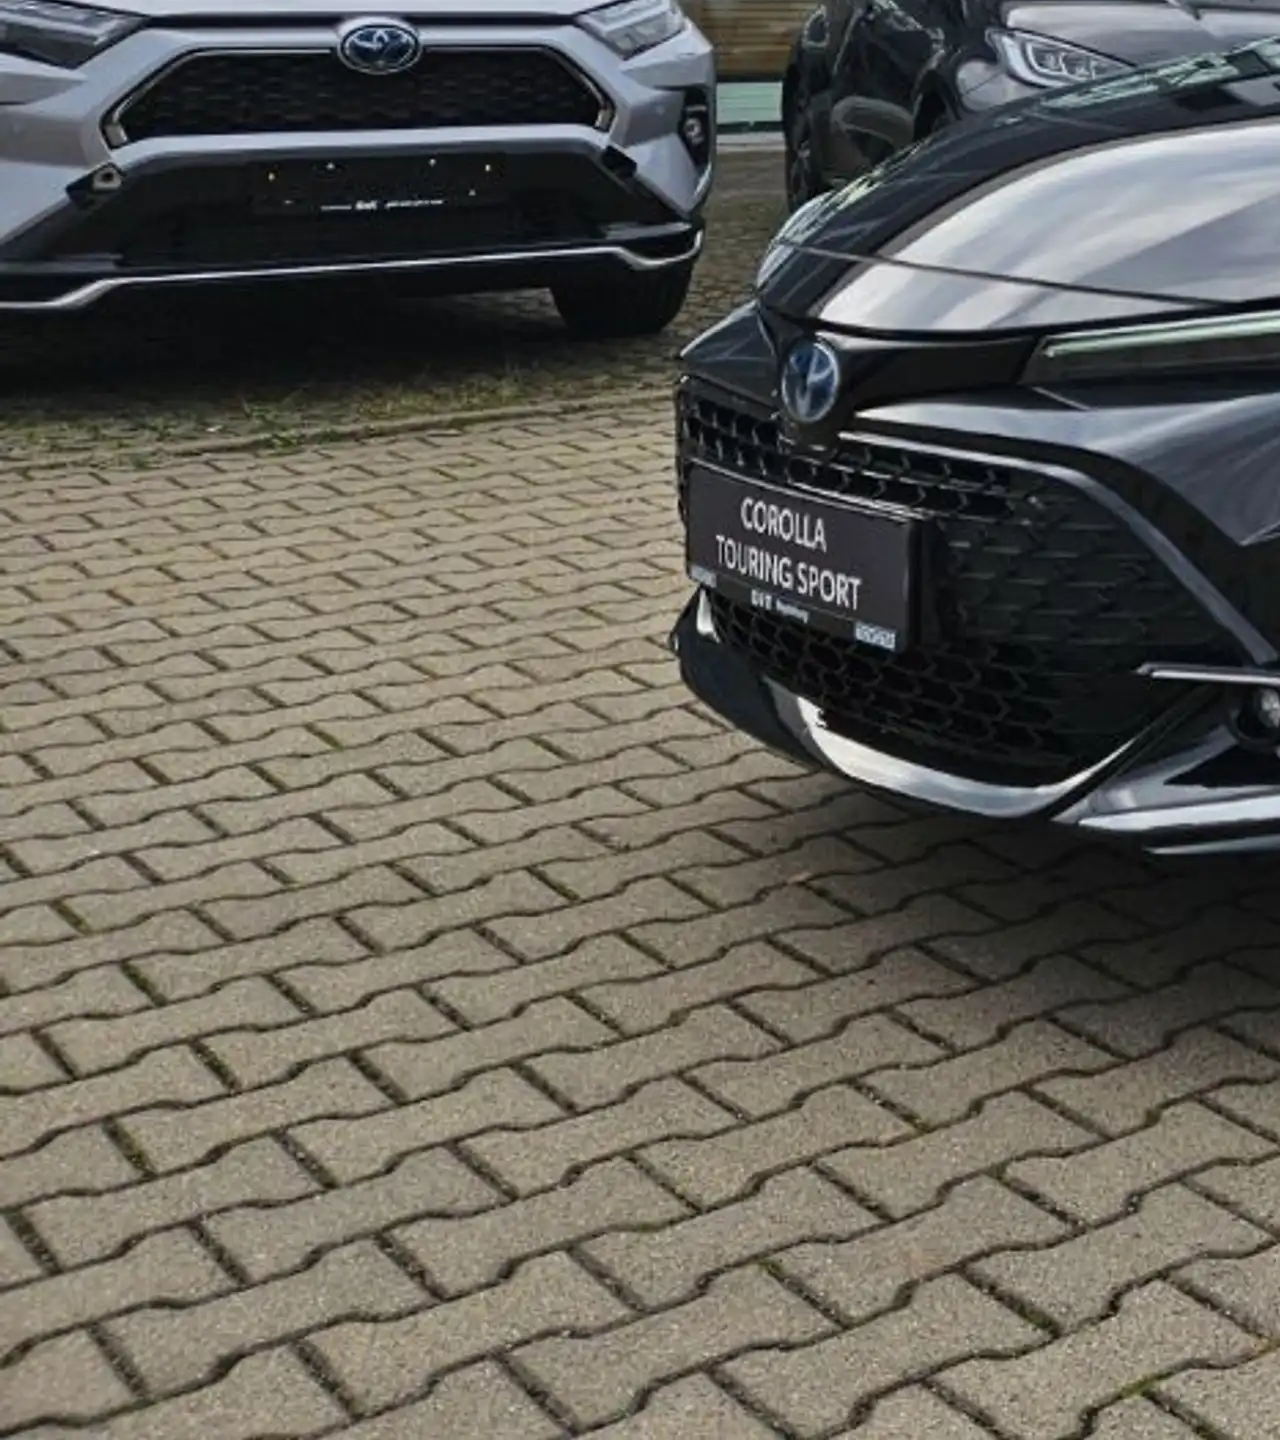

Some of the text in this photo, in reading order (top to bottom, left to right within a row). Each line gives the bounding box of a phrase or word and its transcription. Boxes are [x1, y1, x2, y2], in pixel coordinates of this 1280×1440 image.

[740, 496, 827, 553] COROLLA
[715, 534, 794, 590] TOURING
[797, 561, 862, 611] SPORT
